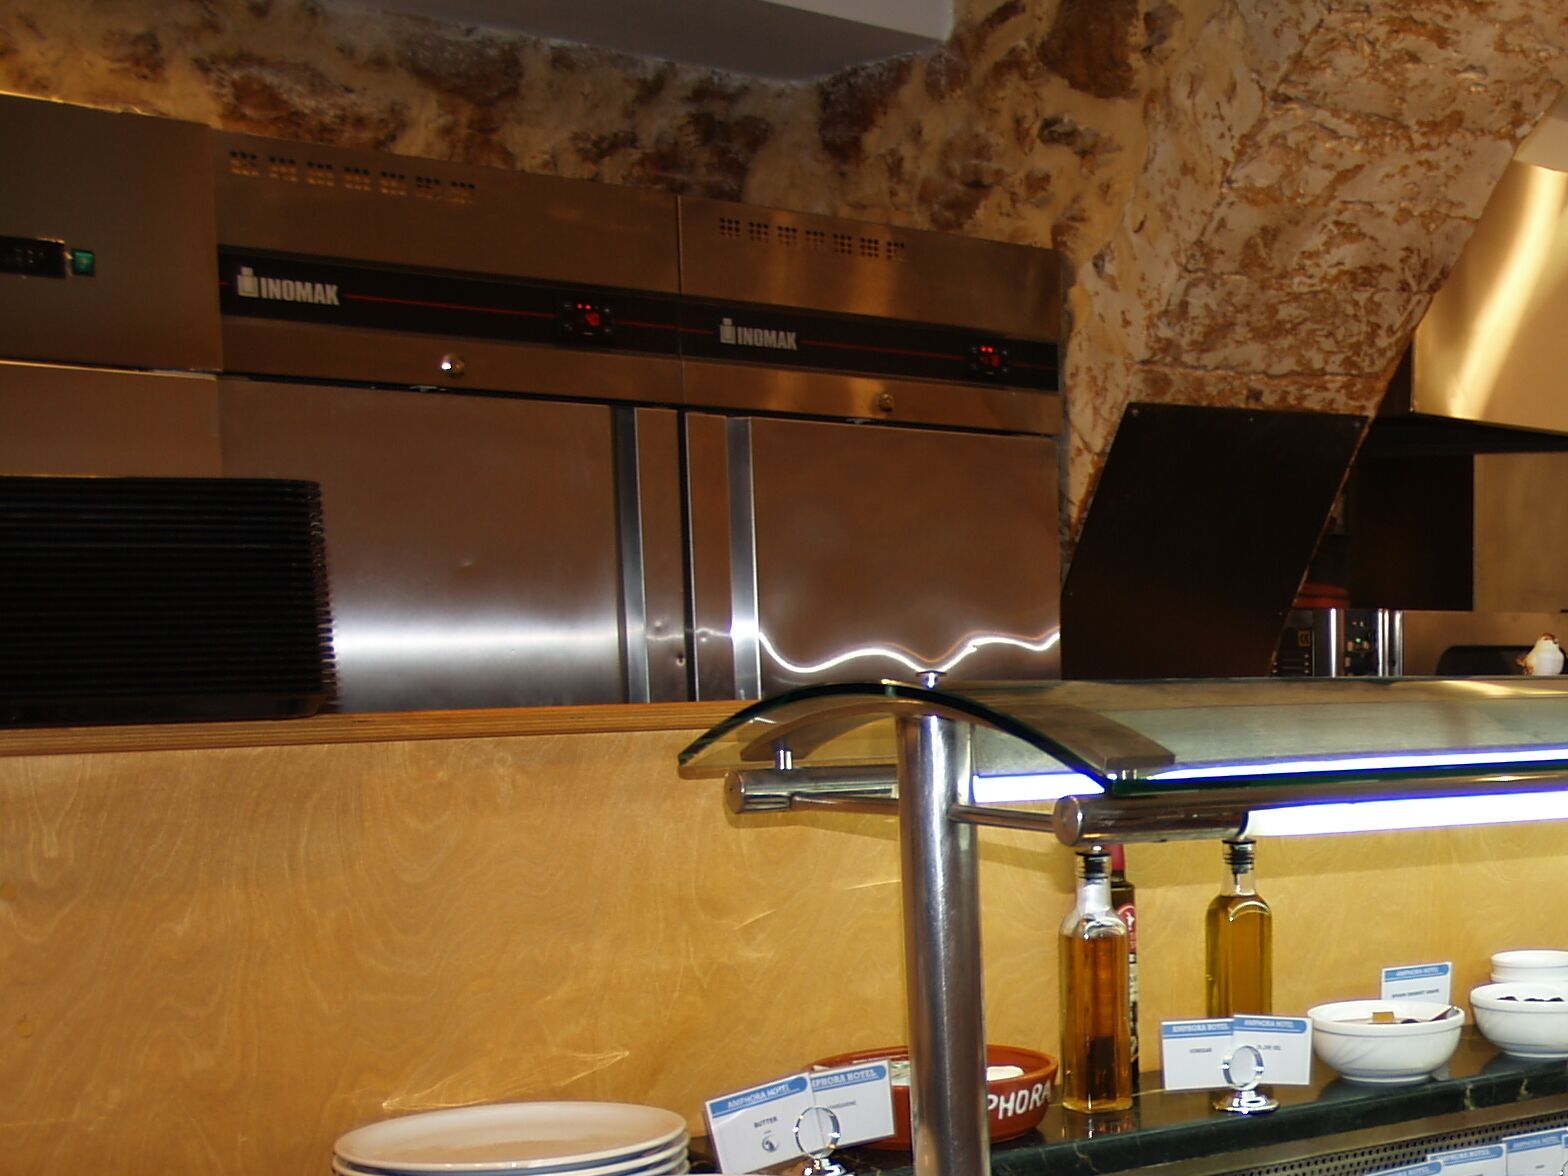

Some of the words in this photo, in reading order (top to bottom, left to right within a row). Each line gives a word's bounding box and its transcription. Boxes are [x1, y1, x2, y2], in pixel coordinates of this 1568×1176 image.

[260, 277, 340, 306] INOMAK
[737, 326, 798, 351] INOMAK
[728, 1091, 766, 1110] AMPHORA
[766, 1084, 791, 1099] HOTEL
[754, 1116, 778, 1129] BUTTER
